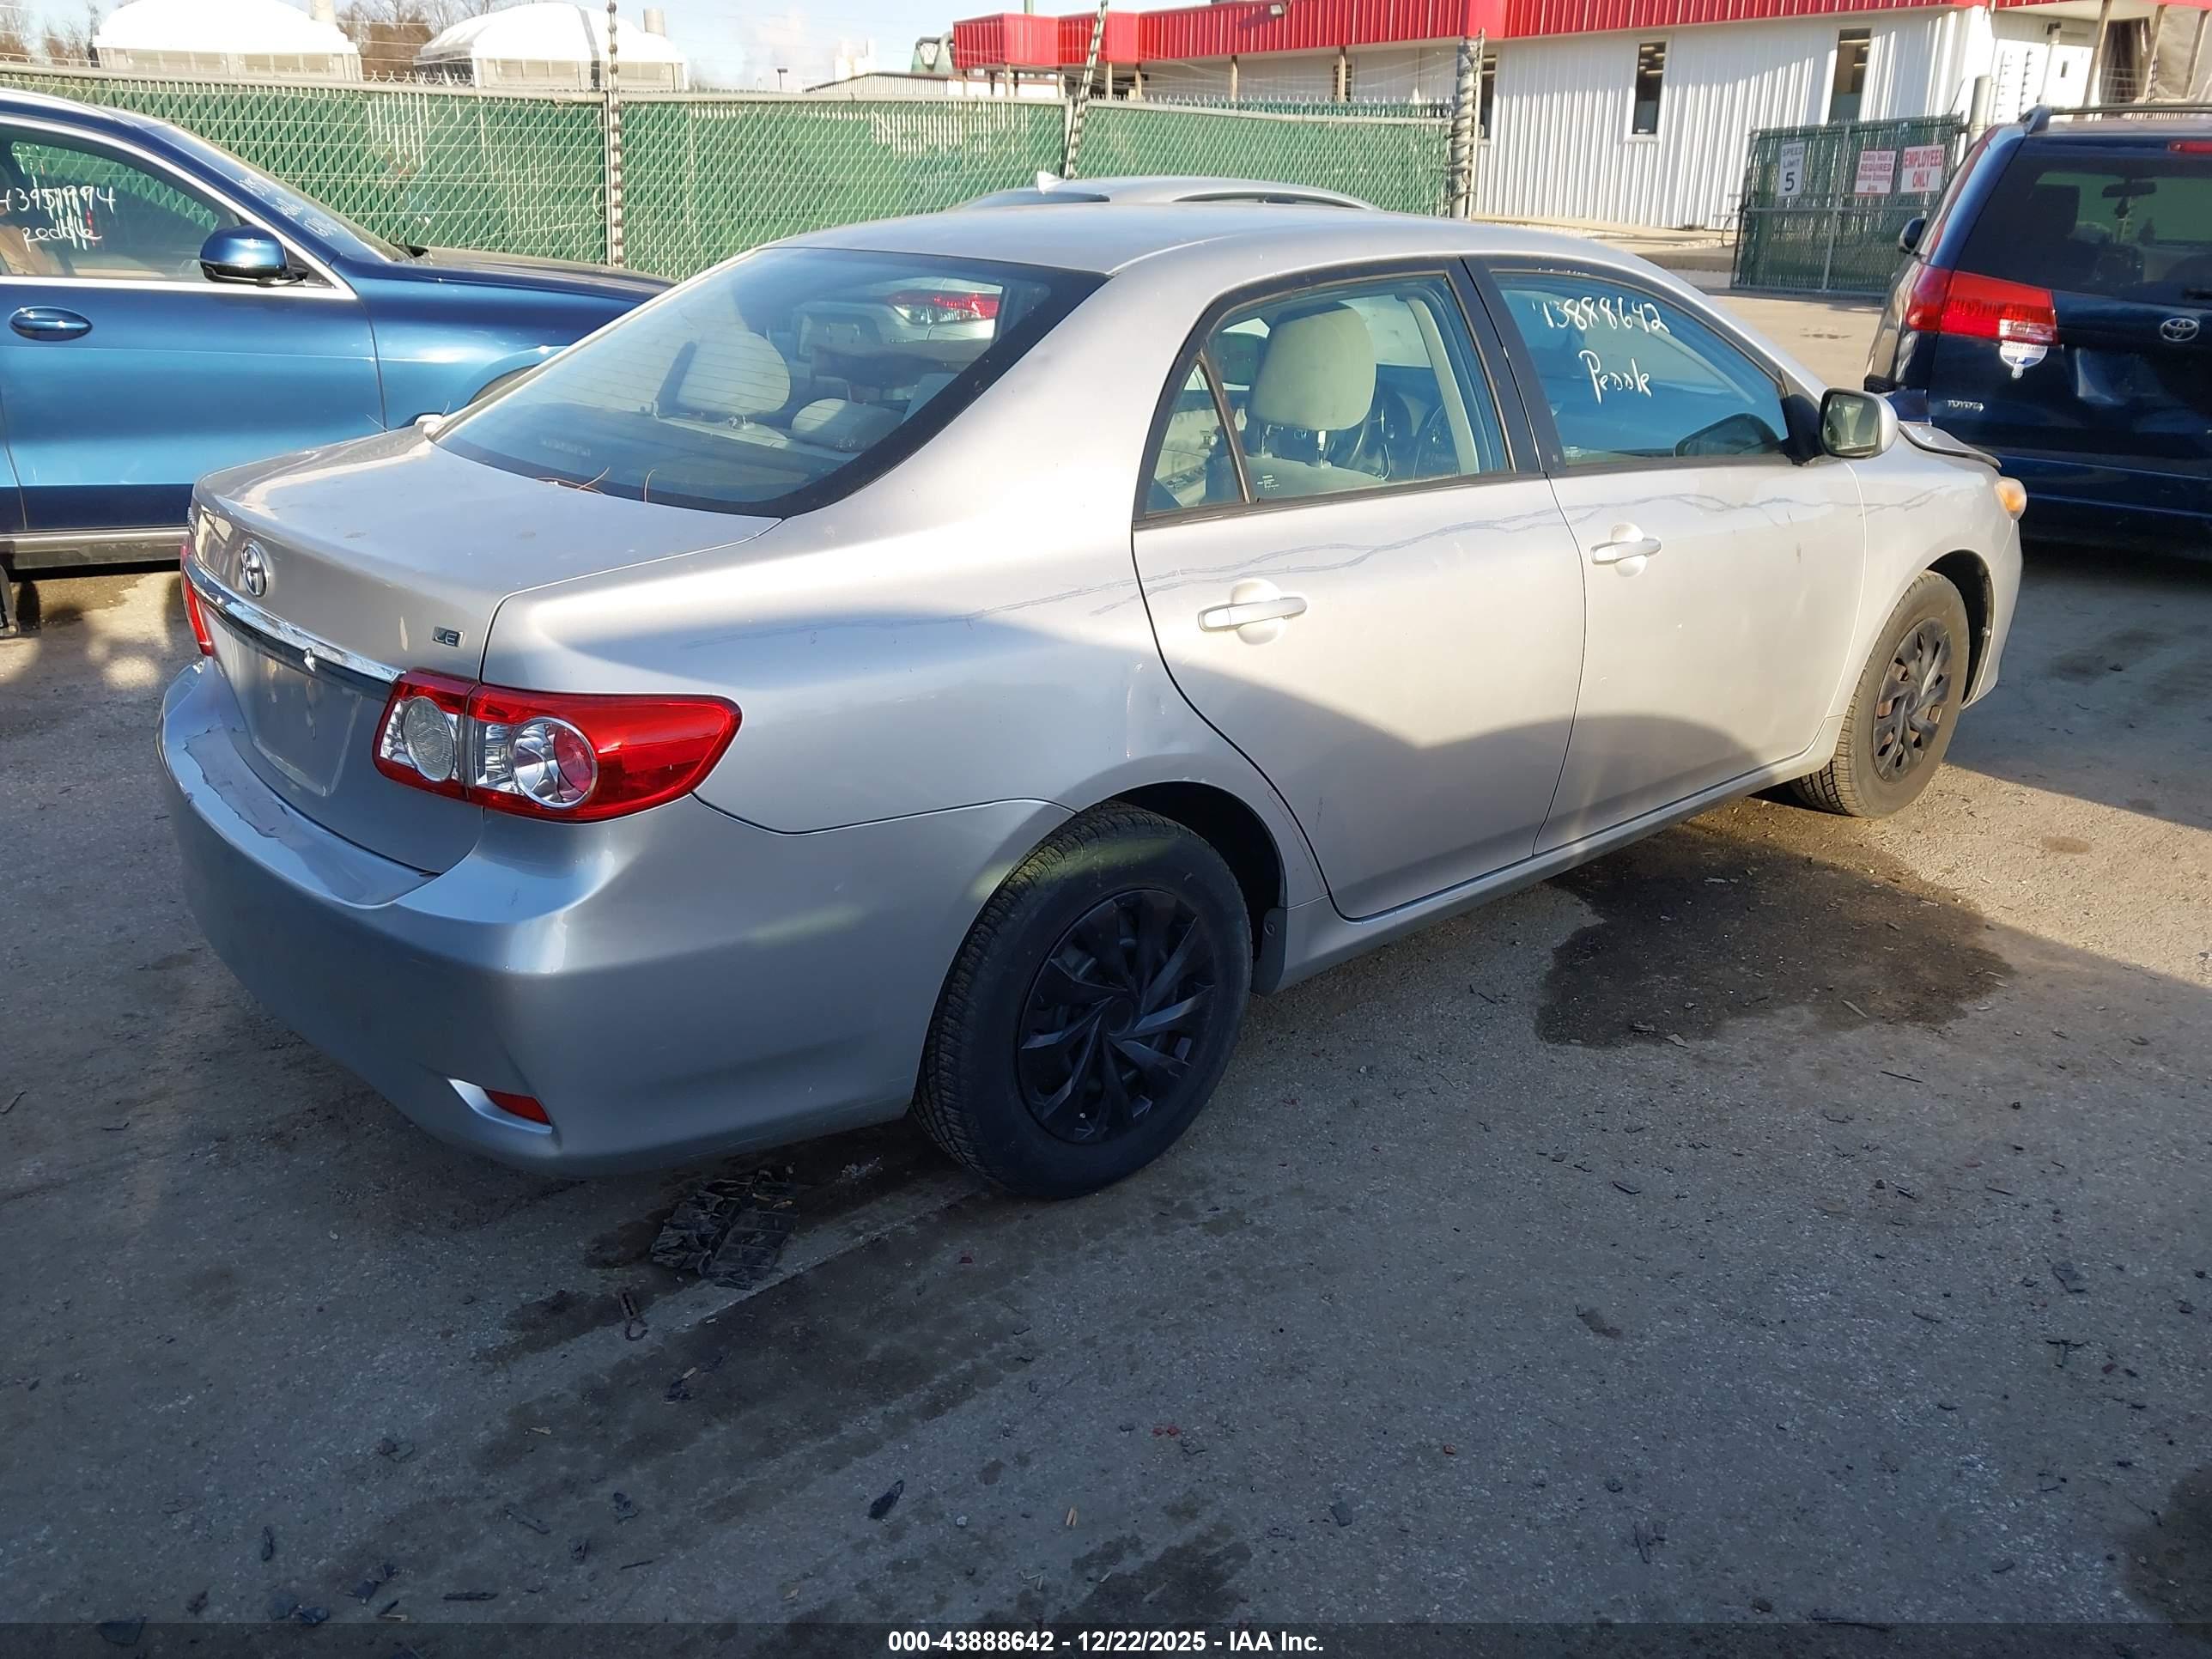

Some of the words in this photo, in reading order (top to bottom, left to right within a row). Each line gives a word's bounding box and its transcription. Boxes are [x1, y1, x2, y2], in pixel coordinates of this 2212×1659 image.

[1783, 146, 1803, 156] SPEED
[1783, 158, 1801, 168] LIMIT
[1904, 149, 1943, 168] EMPLOYEES
[1860, 163, 1892, 172] REQUIRED
[1784, 171, 1795, 191] 5
[1912, 169, 1931, 188] ONLY
